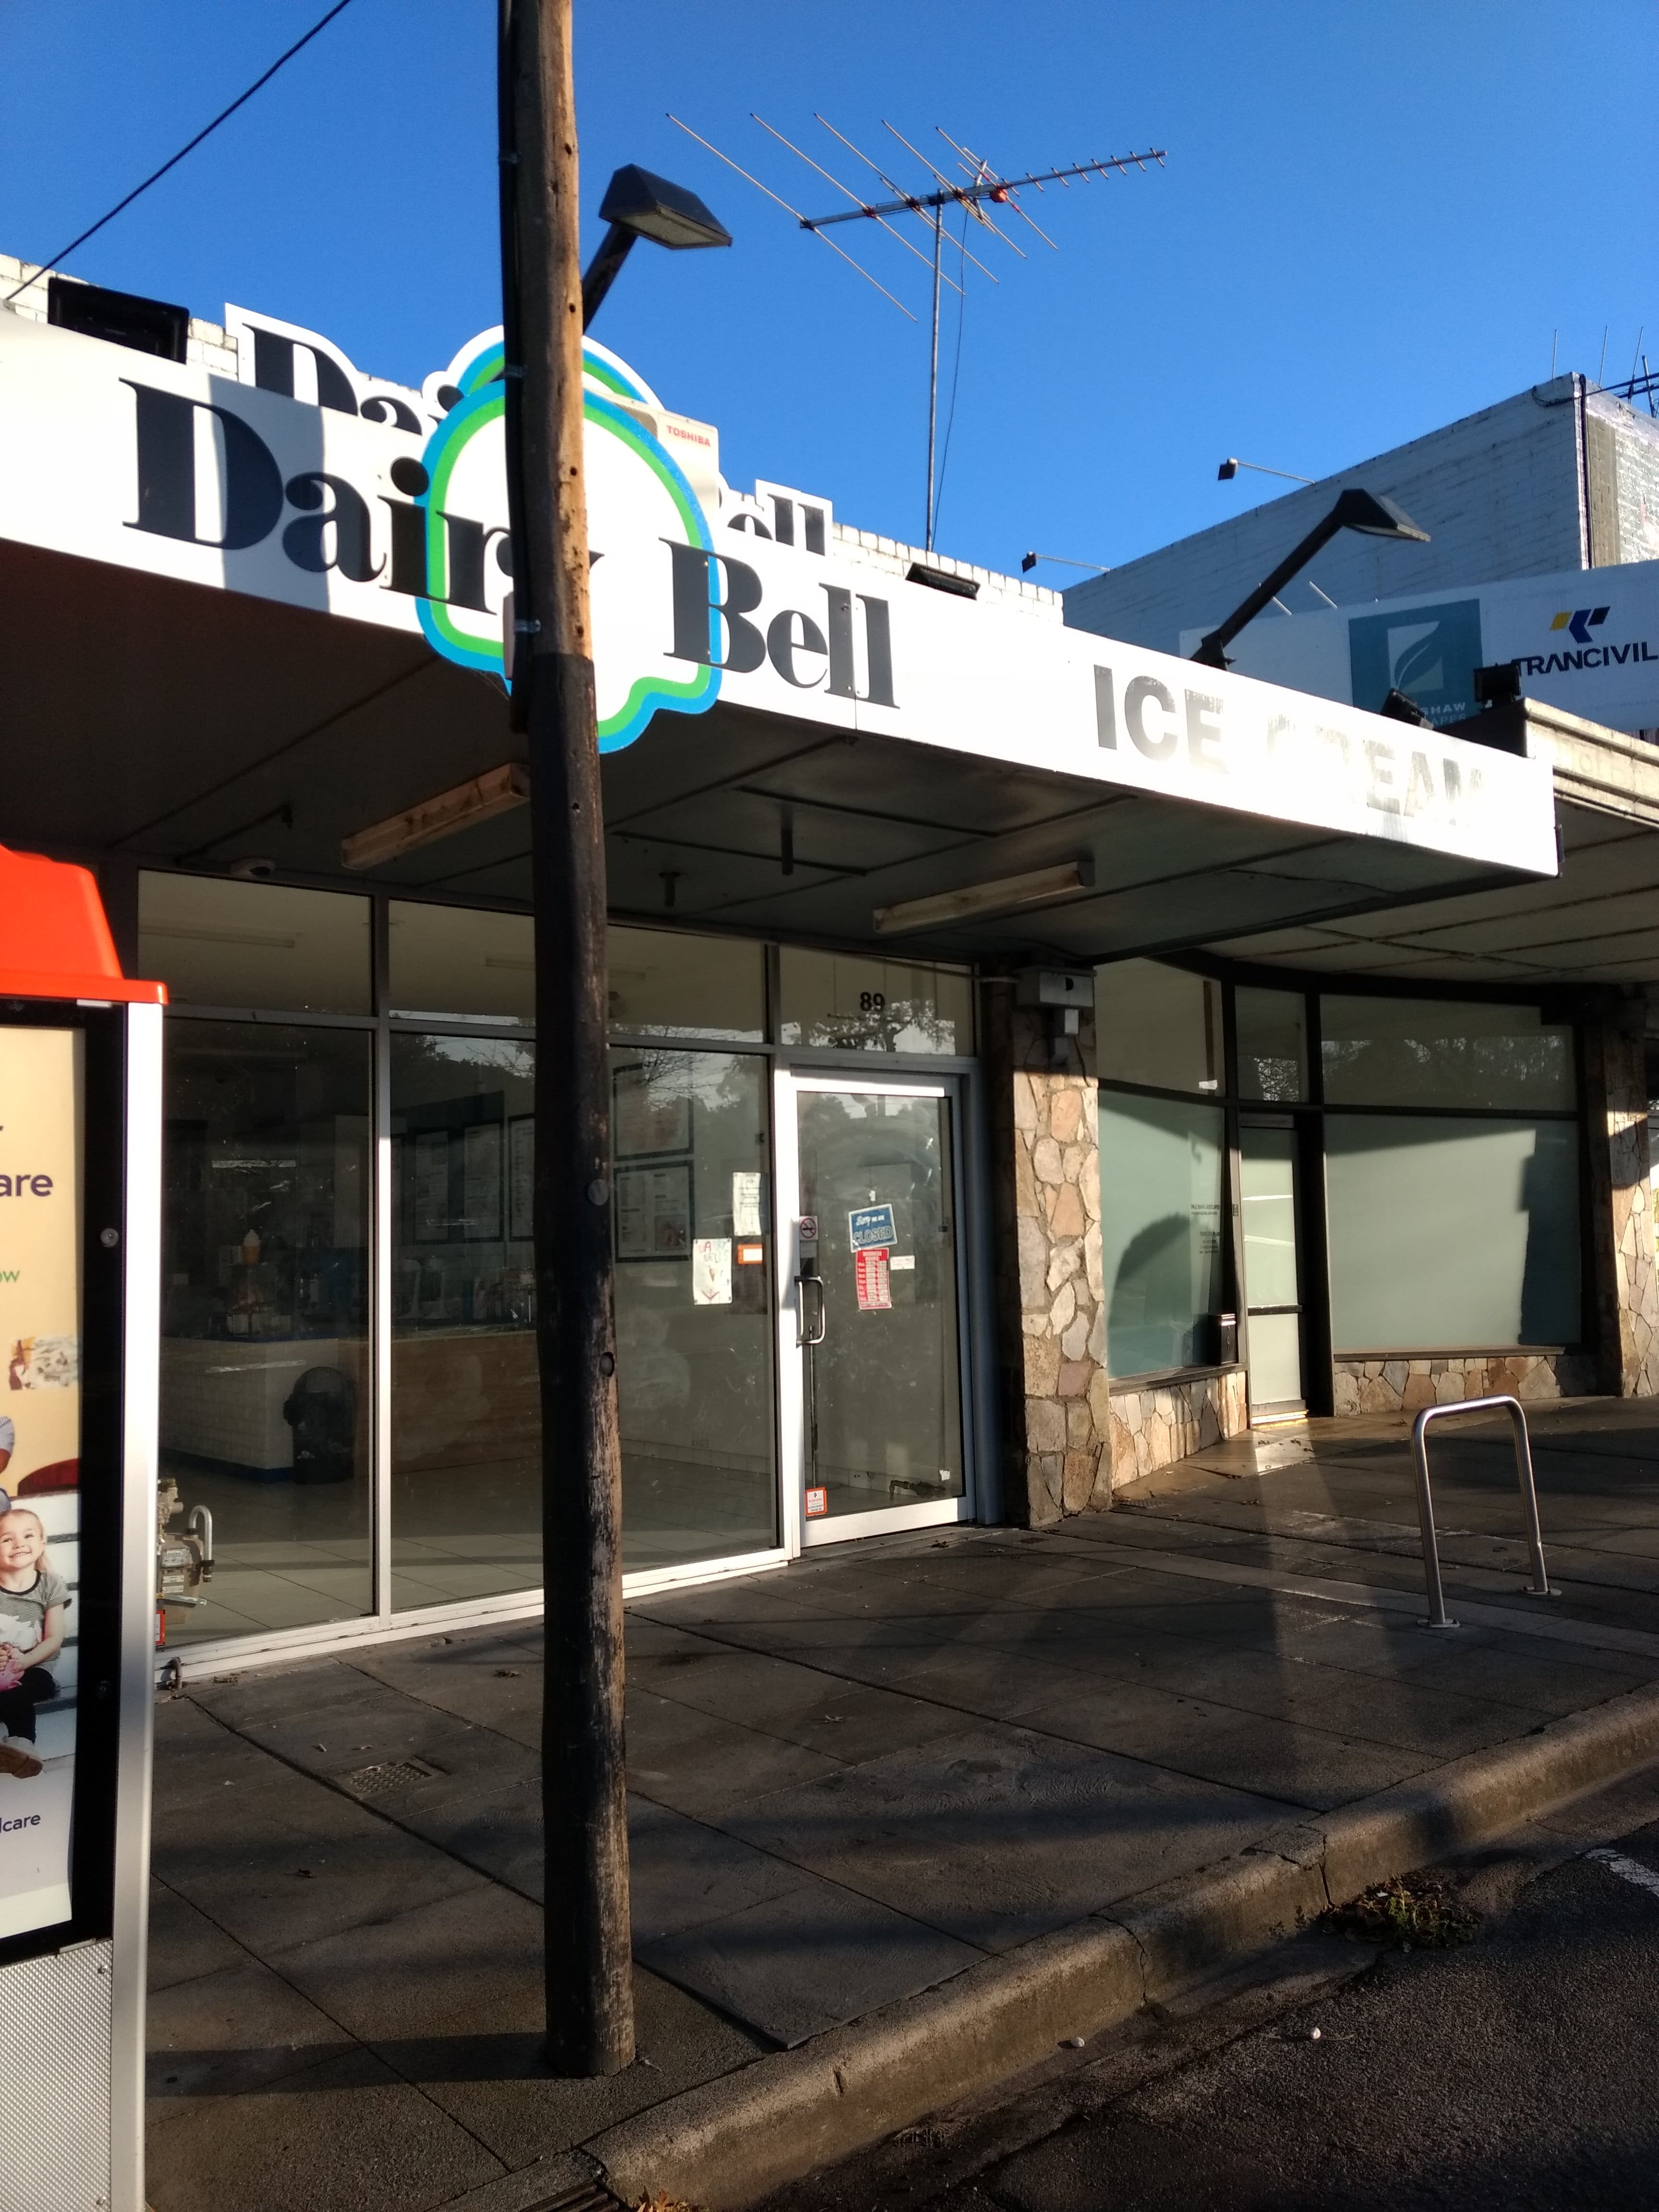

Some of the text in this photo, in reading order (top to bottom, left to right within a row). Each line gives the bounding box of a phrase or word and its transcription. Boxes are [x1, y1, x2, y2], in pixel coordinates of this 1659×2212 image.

[666, 425, 710, 446] TOSHIBA
[118, 377, 901, 709] Dair Bell
[1093, 664, 1230, 775] ICE
[860, 992, 885, 1012] 89
[856, 1215, 871, 1226] Sorry
[853, 1226, 893, 1244] CLOSED
[0, 1270, 20, 1283] w
